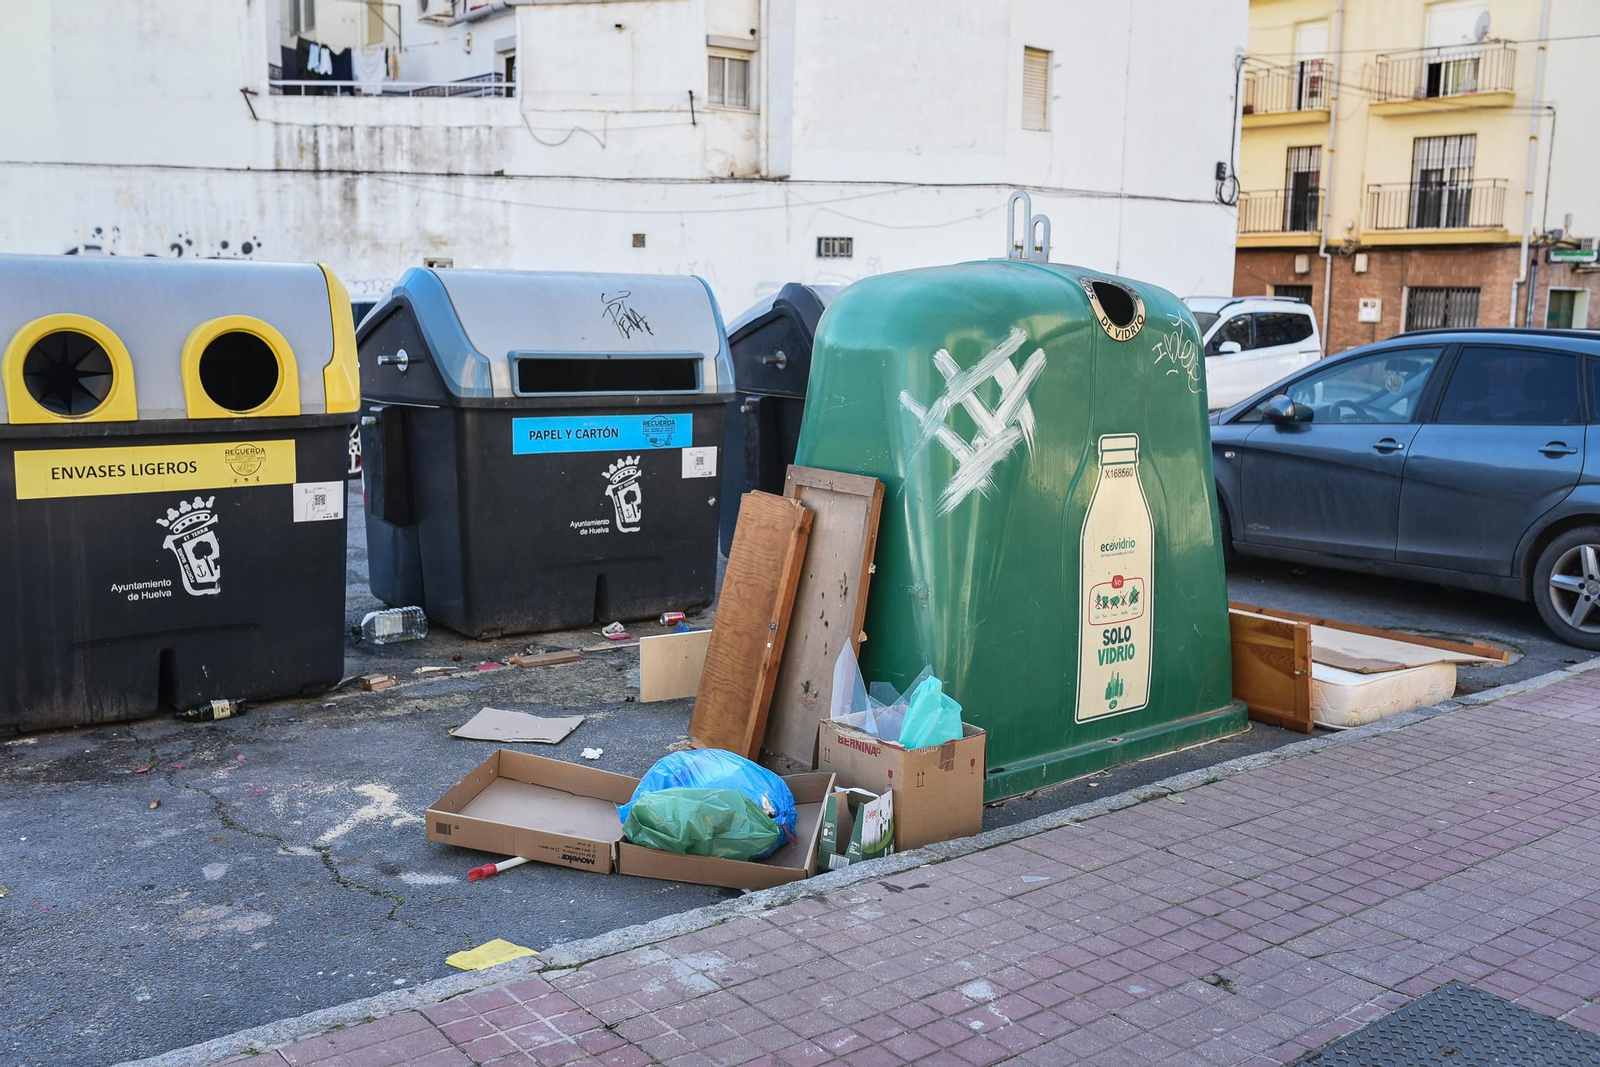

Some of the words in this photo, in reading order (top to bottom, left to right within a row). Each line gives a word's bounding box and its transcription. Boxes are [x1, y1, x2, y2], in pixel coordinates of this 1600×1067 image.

[1100, 315, 1113, 334] DE
[1114, 314, 1145, 340] VIDRIO
[642, 419, 676, 428] RECUERDA
[529, 429, 563, 441] PAPEL
[565, 429, 572, 440] Y
[575, 425, 619, 439] CARTÓN
[225, 447, 266, 456] RECUERDA
[51, 464, 126, 480] ENVASES
[131, 461, 198, 477] LIGEROS
[1104, 467, 1134, 479] X168560
[570, 518, 610, 529] Ayuntamiento
[589, 527, 610, 535] Huelva
[1100, 538, 1136, 553] ecovidrio
[110, 579, 172, 594] Ayuntamiento
[127, 592, 140, 601] de
[141, 589, 172, 600] Huelva
[1102, 625, 1132, 646] SOLO
[1098, 643, 1136, 667] VIDRIO
[837, 734, 878, 757] BERNINA
